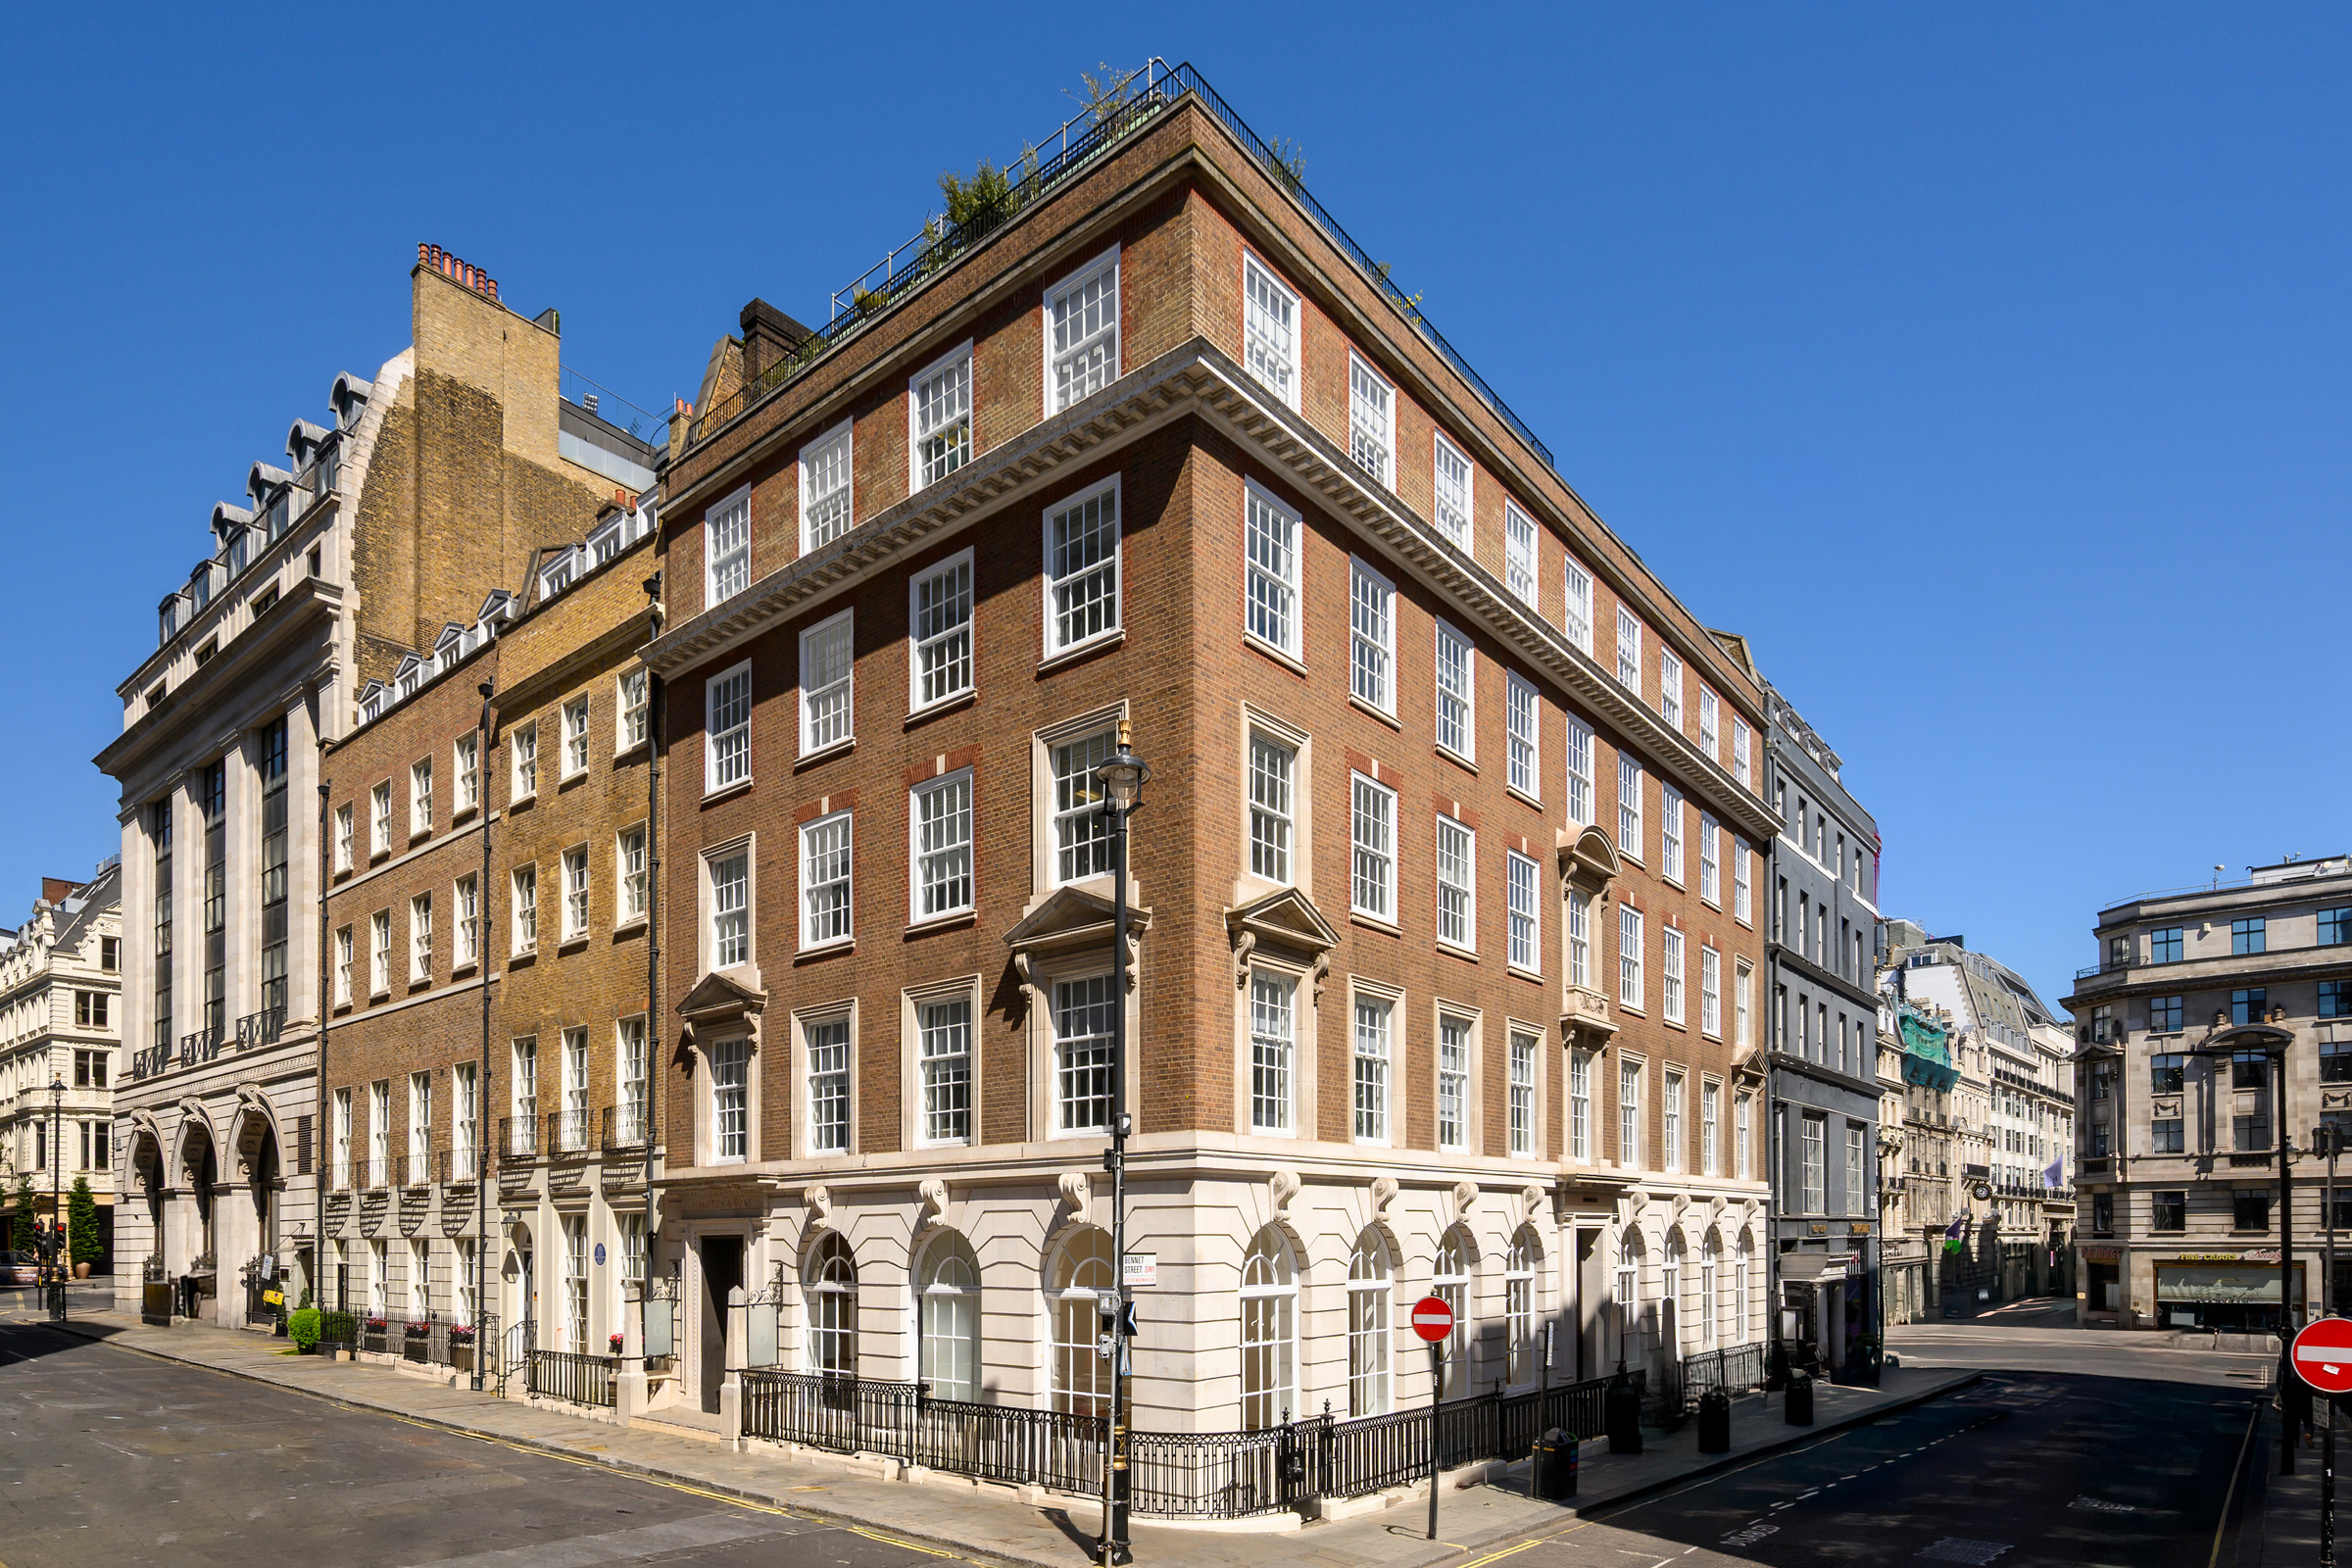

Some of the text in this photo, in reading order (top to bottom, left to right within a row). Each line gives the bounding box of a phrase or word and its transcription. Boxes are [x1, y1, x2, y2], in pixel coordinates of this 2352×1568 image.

[692, 1200, 725, 1209] HAMPTON
[734, 1198, 752, 1208] SONS
[2082, 1249, 2123, 1260] DAVIDOFF
[653, 1317, 663, 1337] 6
